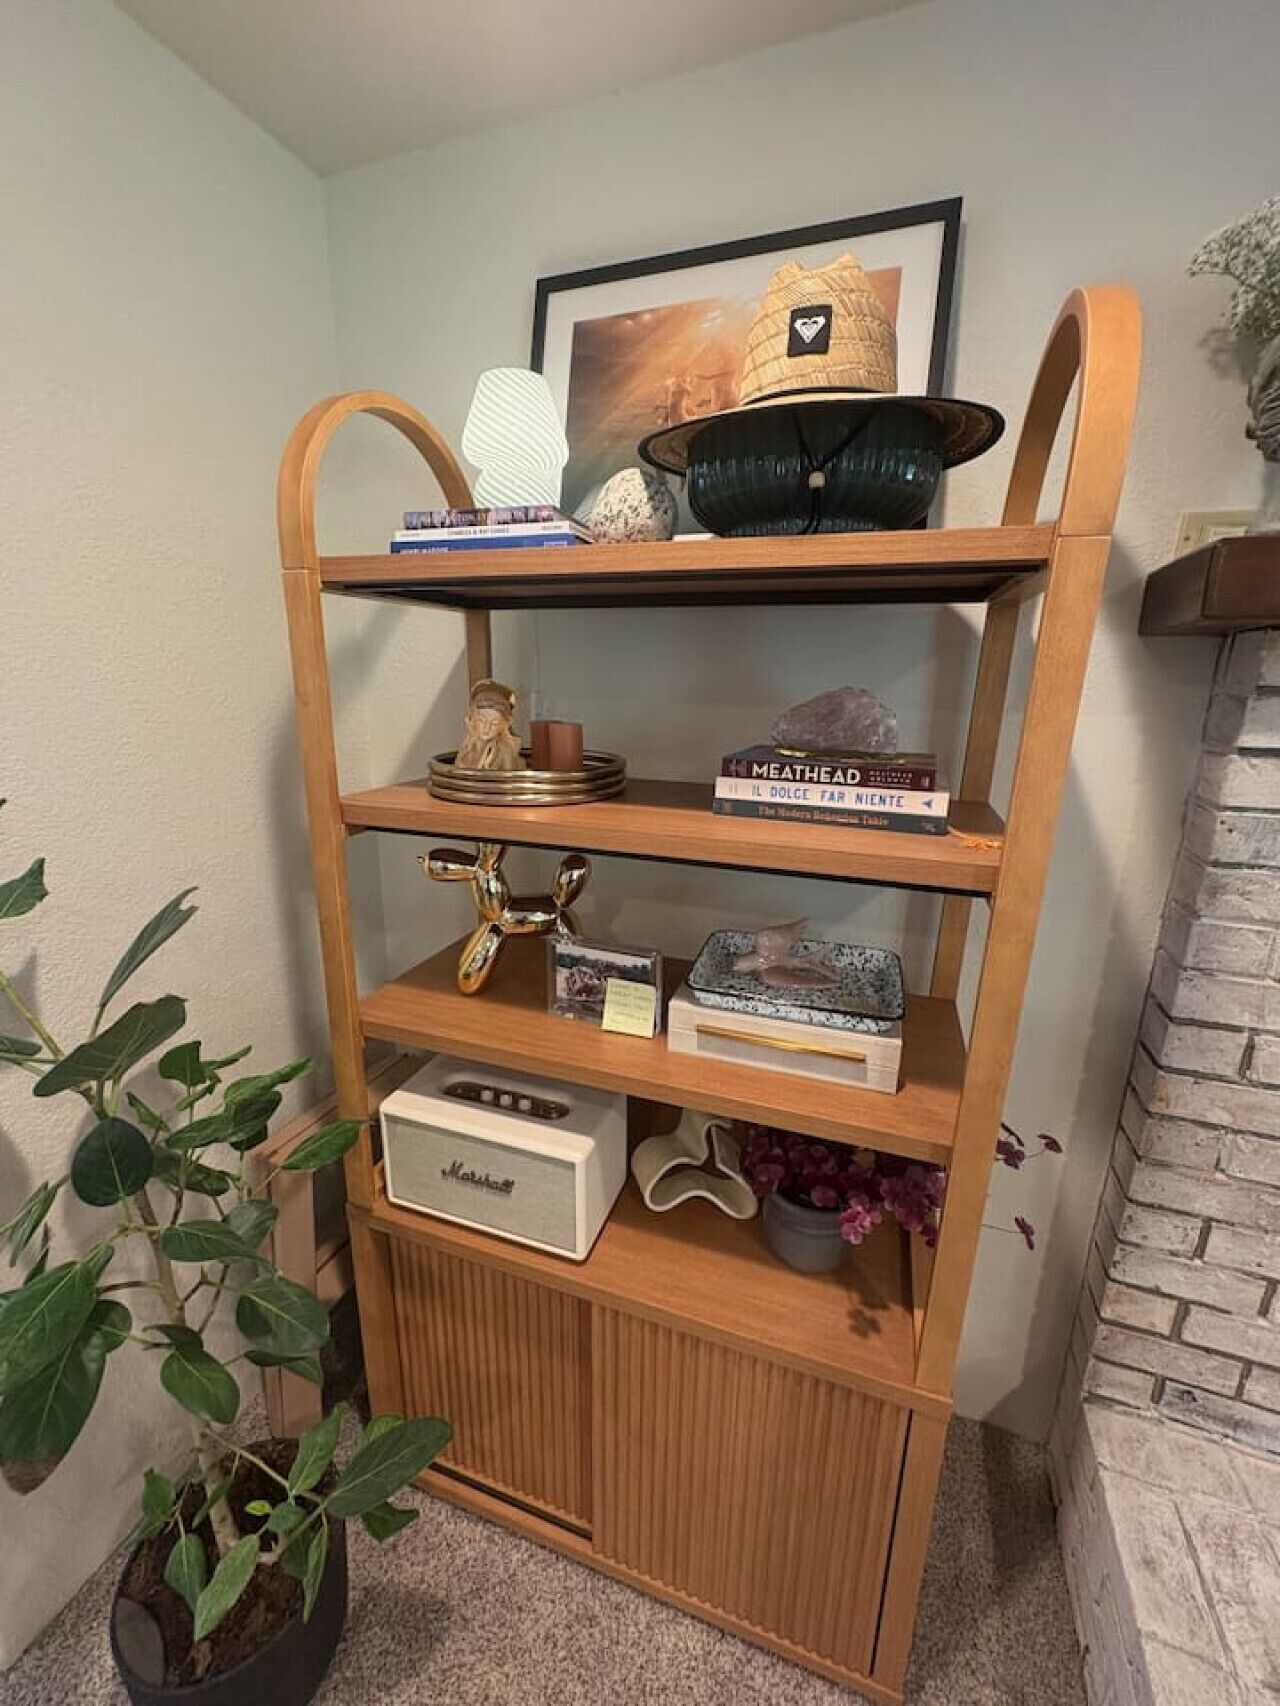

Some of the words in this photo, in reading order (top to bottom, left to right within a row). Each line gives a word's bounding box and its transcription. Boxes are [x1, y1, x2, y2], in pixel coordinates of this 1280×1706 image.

[752, 763, 861, 785] MEATHEAD
[752, 785, 762, 797] IL
[769, 786, 810, 800] DOLCE
[820, 790, 846, 802] FAR
[855, 793, 905, 808] NIENTE
[441, 1160, 514, 1194] Marshall
